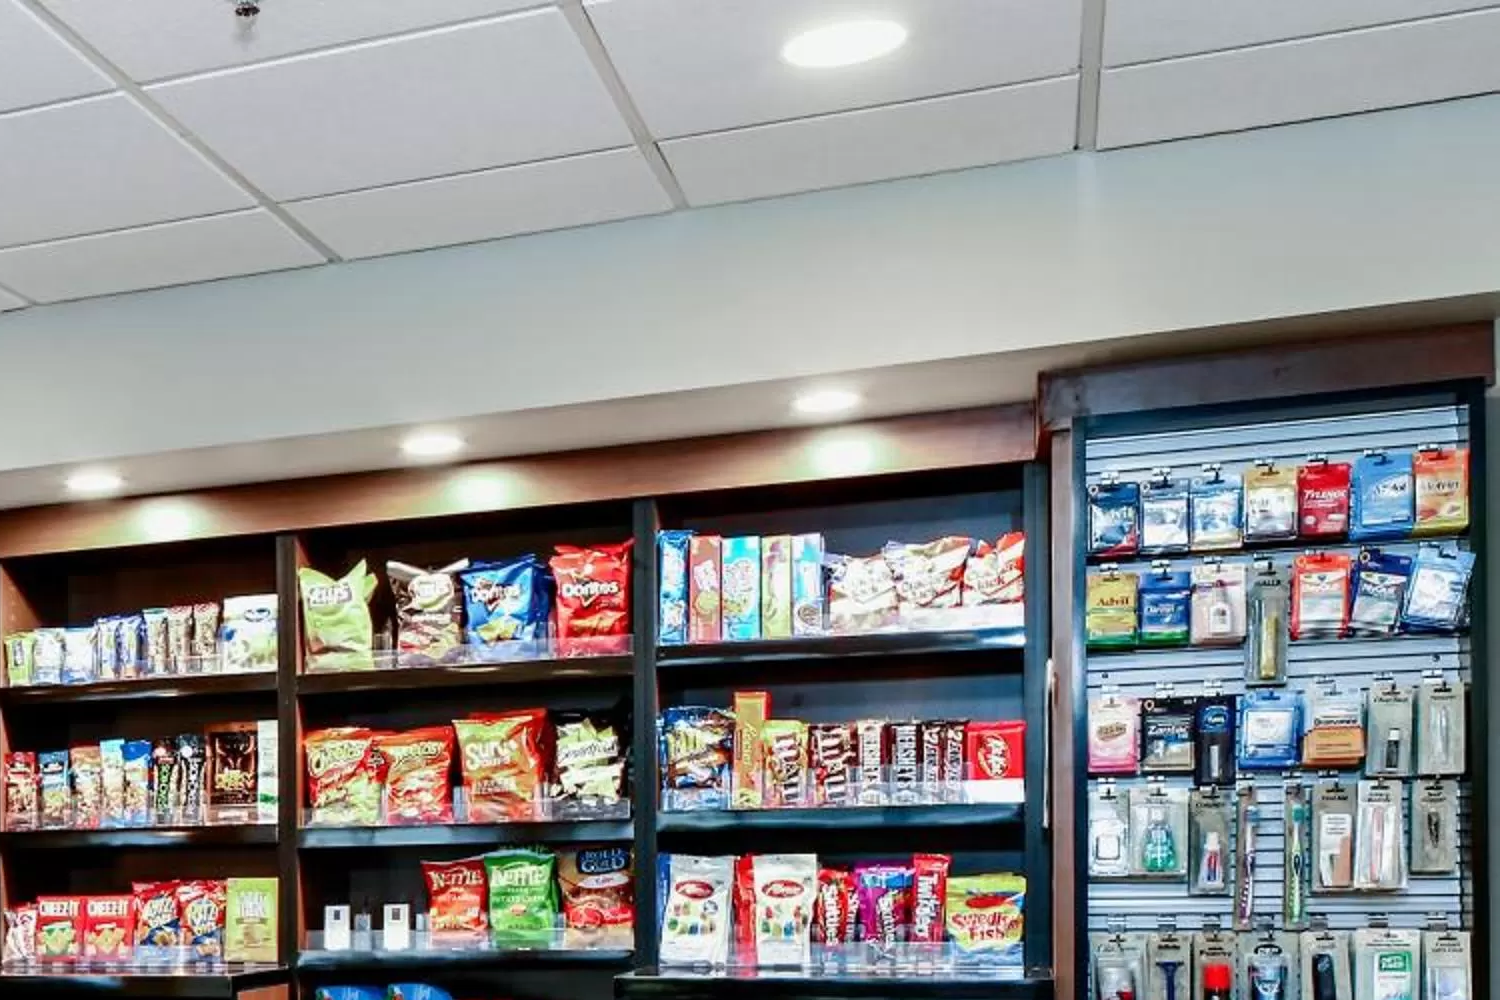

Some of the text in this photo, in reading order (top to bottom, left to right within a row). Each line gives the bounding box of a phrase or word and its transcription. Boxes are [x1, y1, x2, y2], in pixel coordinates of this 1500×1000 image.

[1304, 488, 1348, 500] TYLENOL
[471, 583, 521, 603] Doritos
[561, 581, 620, 598] Doritos
[465, 740, 512, 770] Sun
[896, 725, 917, 790] HERSHEY'S
[580, 857, 626, 873] GOLD
[822, 883, 840, 946] Skittles
